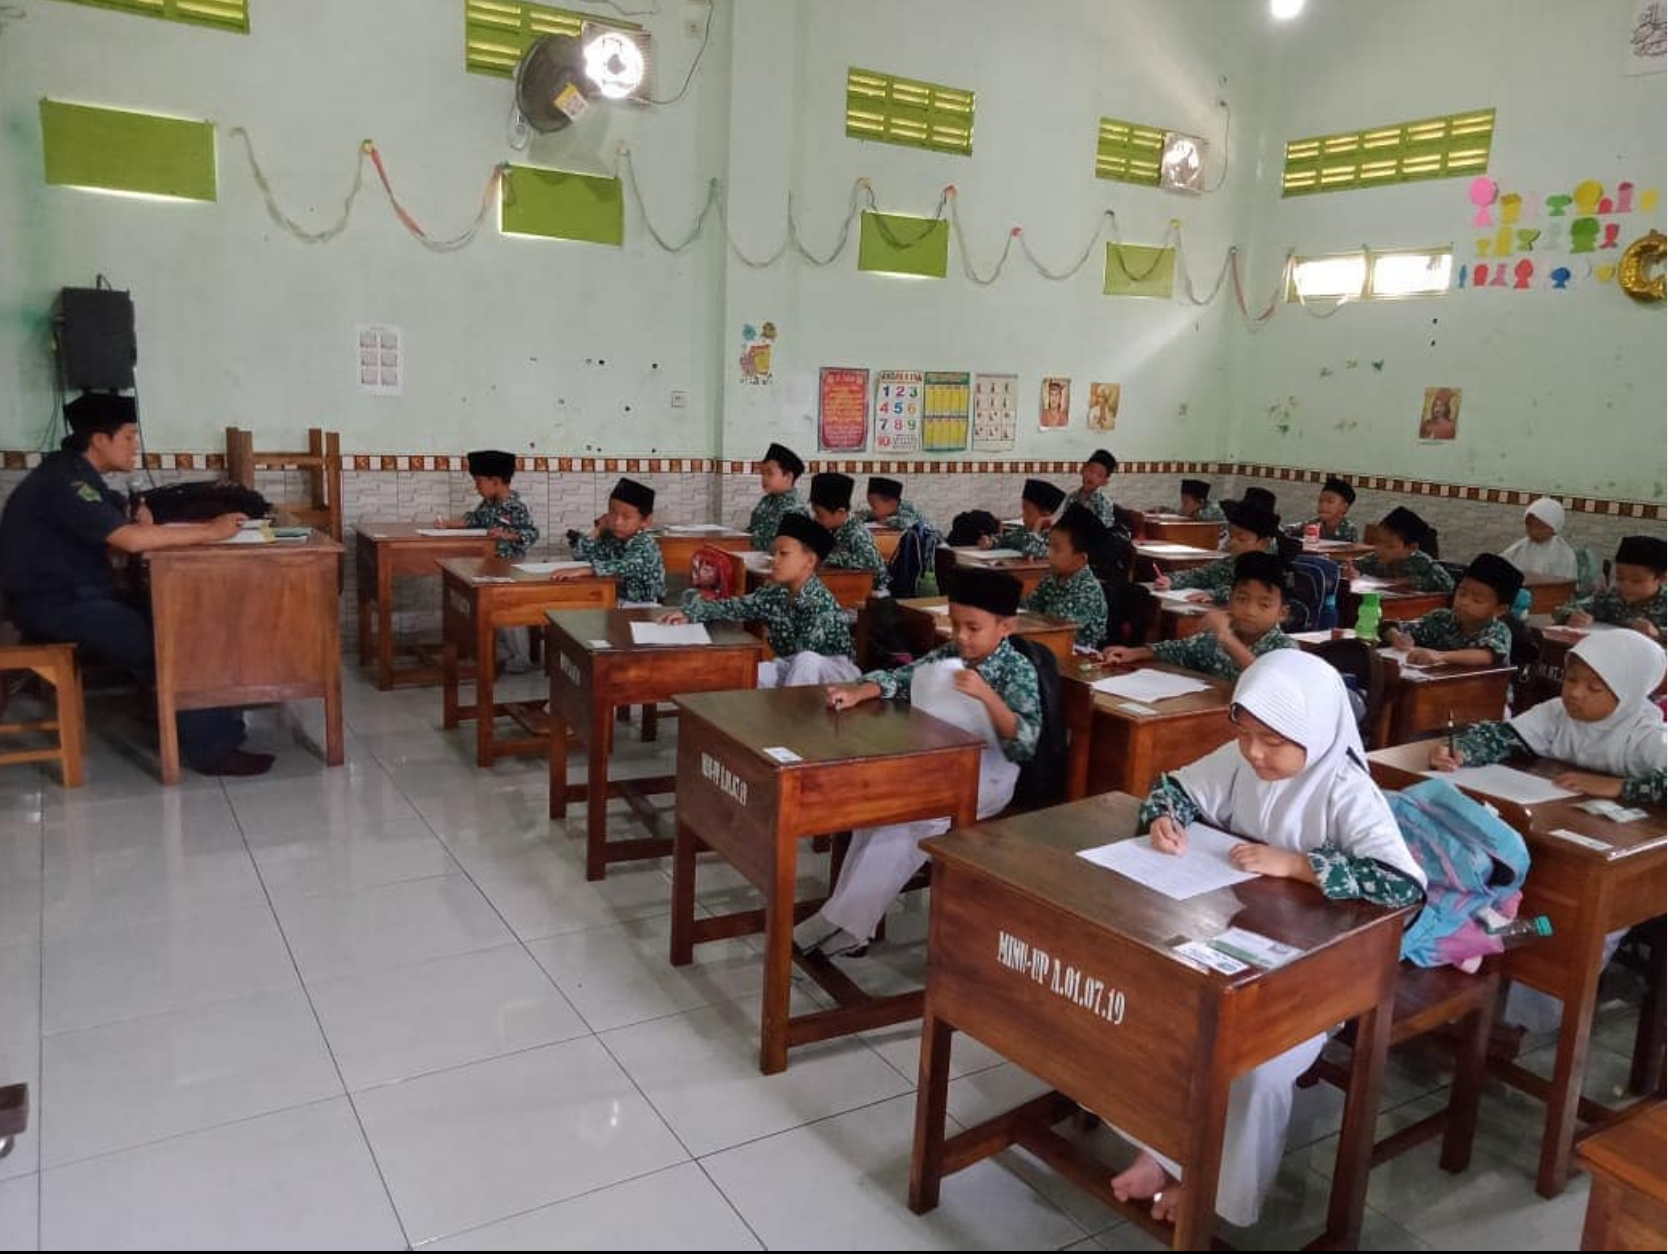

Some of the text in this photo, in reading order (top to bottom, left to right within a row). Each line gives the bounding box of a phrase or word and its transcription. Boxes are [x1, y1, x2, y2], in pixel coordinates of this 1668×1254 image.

[882, 386, 918, 398] 1 2 3
[879, 402, 916, 415] 4 5 6
[879, 418, 916, 431] 7 8 9
[876, 436, 891, 447] 10
[1051, 957, 1126, 1025] A.01.07.19
